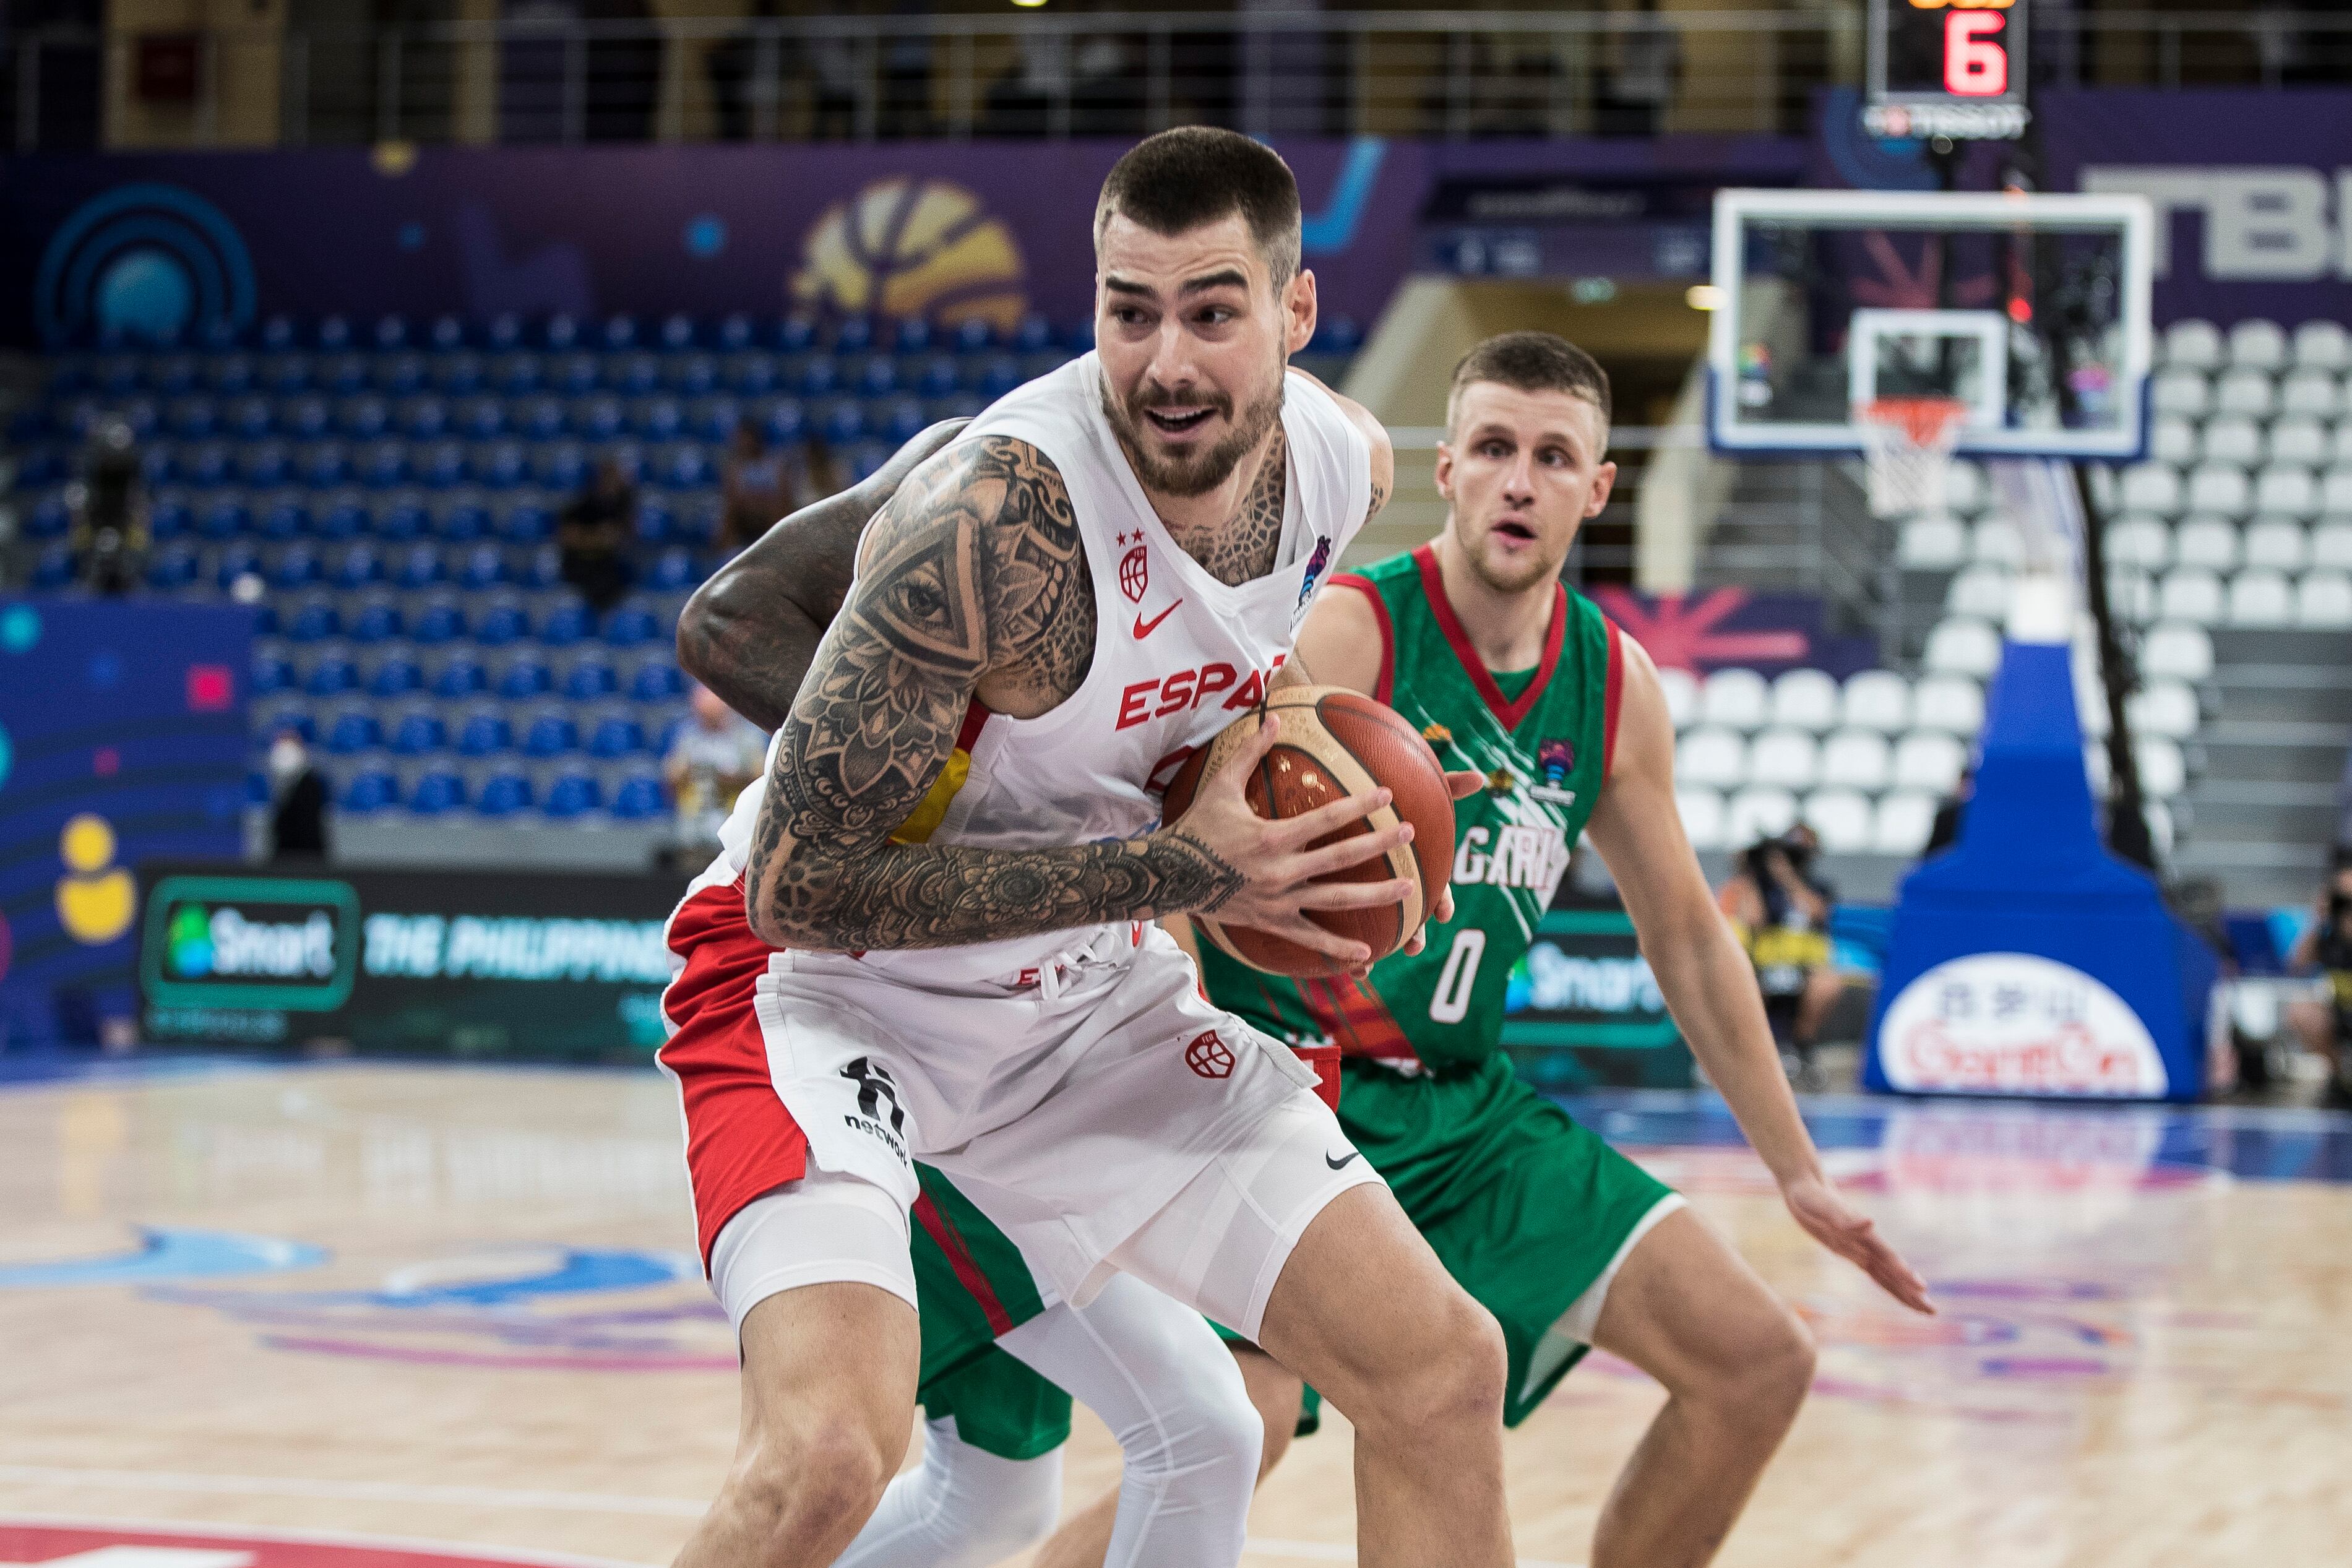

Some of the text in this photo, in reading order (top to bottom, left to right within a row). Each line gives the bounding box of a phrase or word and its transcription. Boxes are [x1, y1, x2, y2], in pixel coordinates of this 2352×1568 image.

[1944, 9, 2007, 97] 6
[1116, 653, 1286, 731] ESPA
[1429, 928, 1486, 1024] 0
[844, 1114, 909, 1170] network
